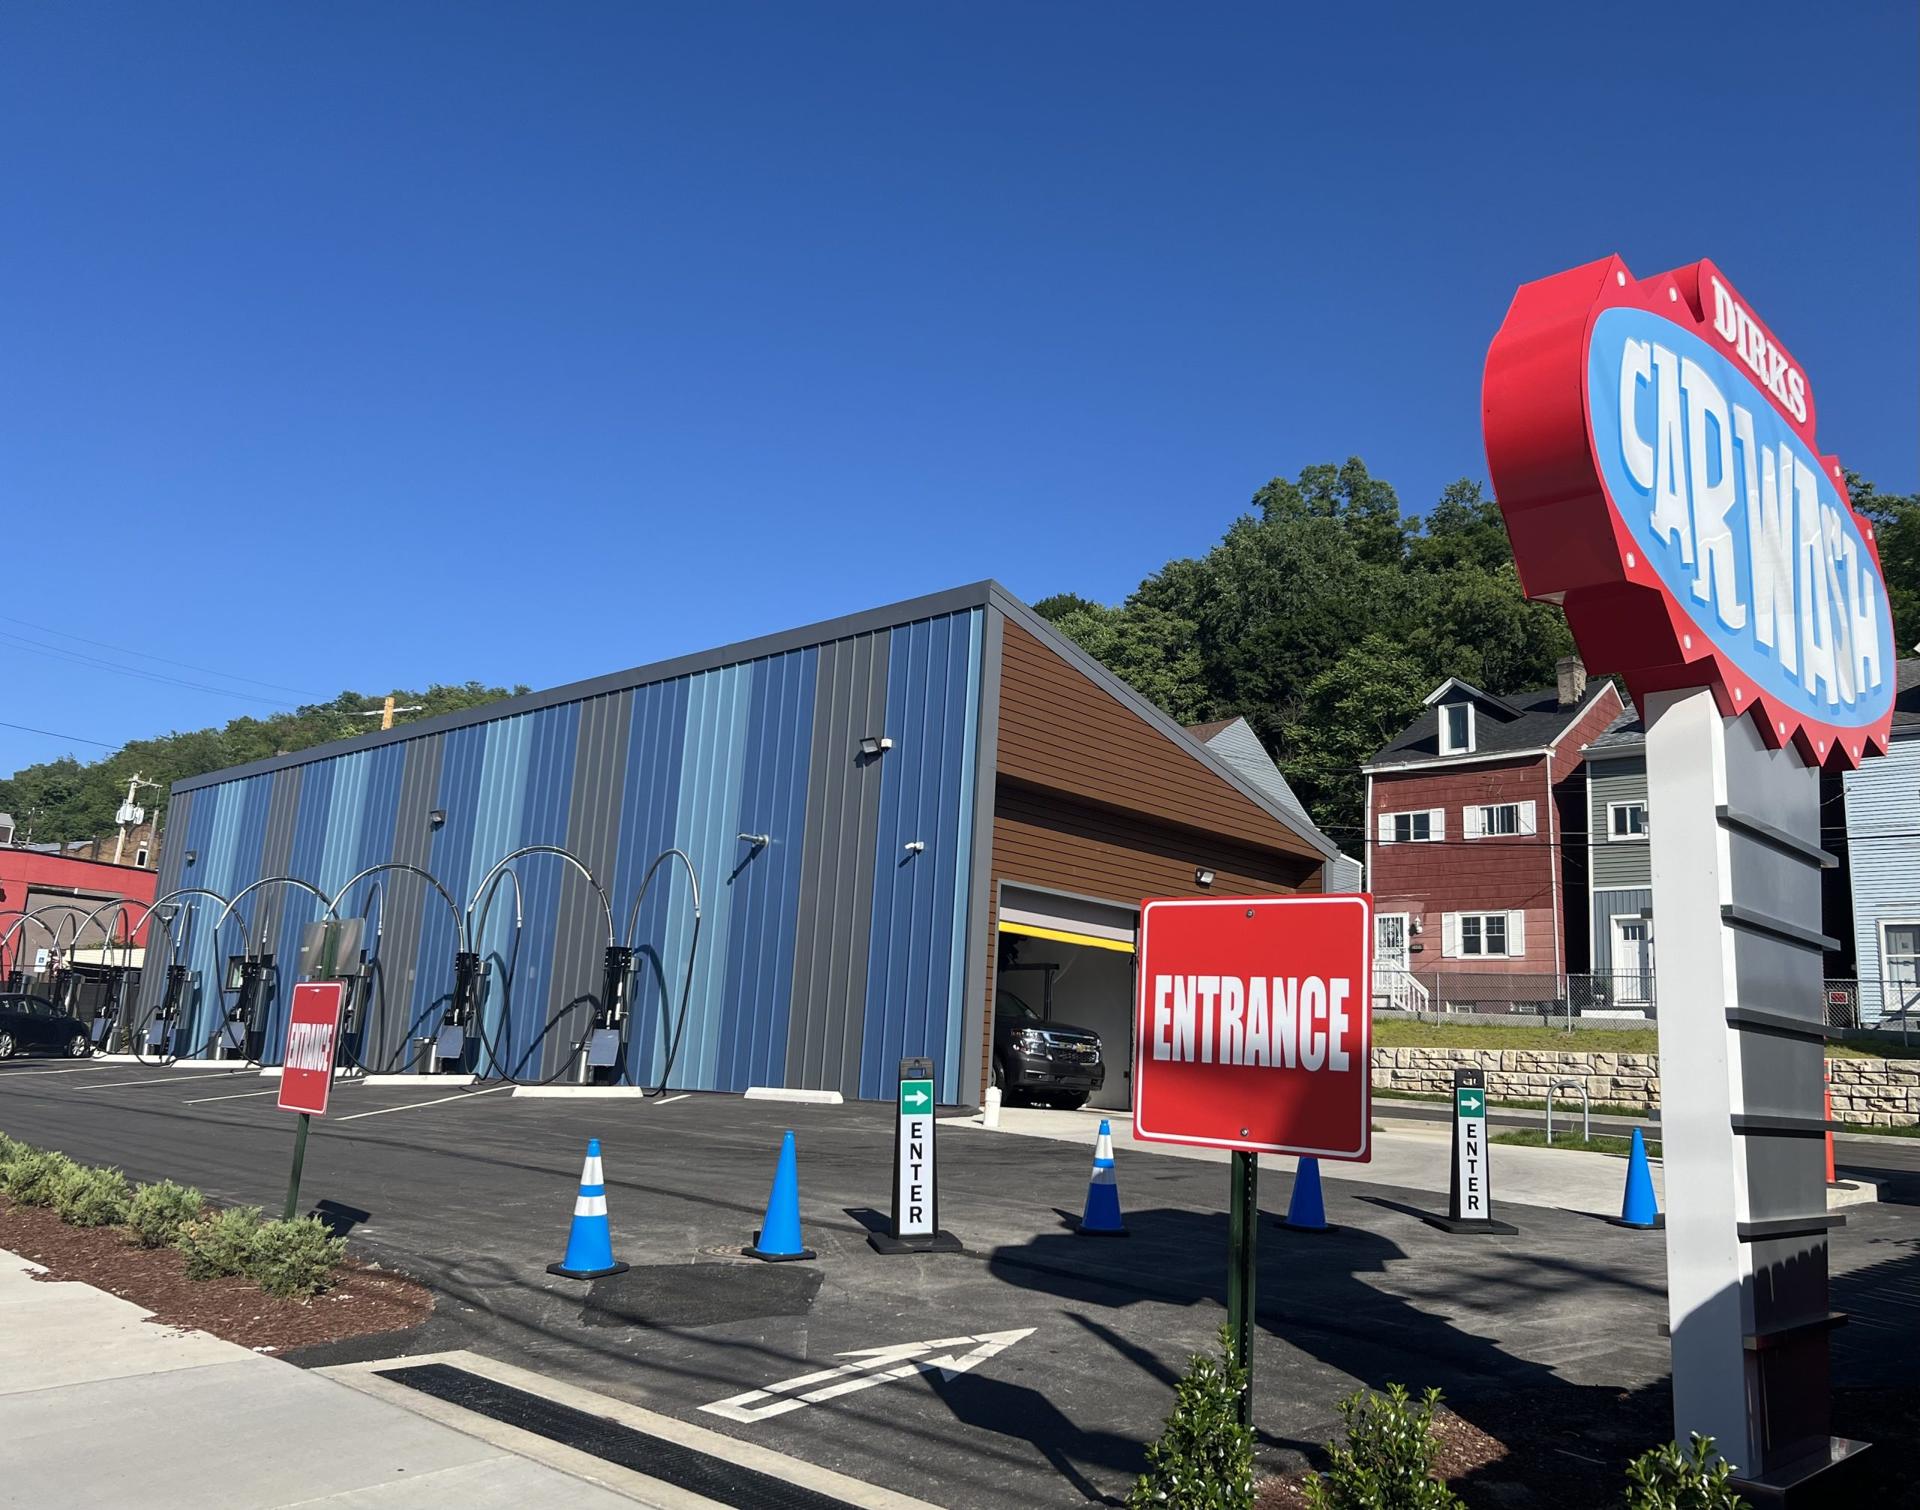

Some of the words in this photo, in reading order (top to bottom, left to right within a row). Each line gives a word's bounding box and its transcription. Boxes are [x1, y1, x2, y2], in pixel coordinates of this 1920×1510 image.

[1711, 276, 1806, 424] DIRKS
[287, 1023, 333, 1072] ENTRANCE
[1153, 975, 1350, 1073] ENTRANCE
[909, 1121, 923, 1224] ENTER
[1466, 1123, 1479, 1210] ENTER
